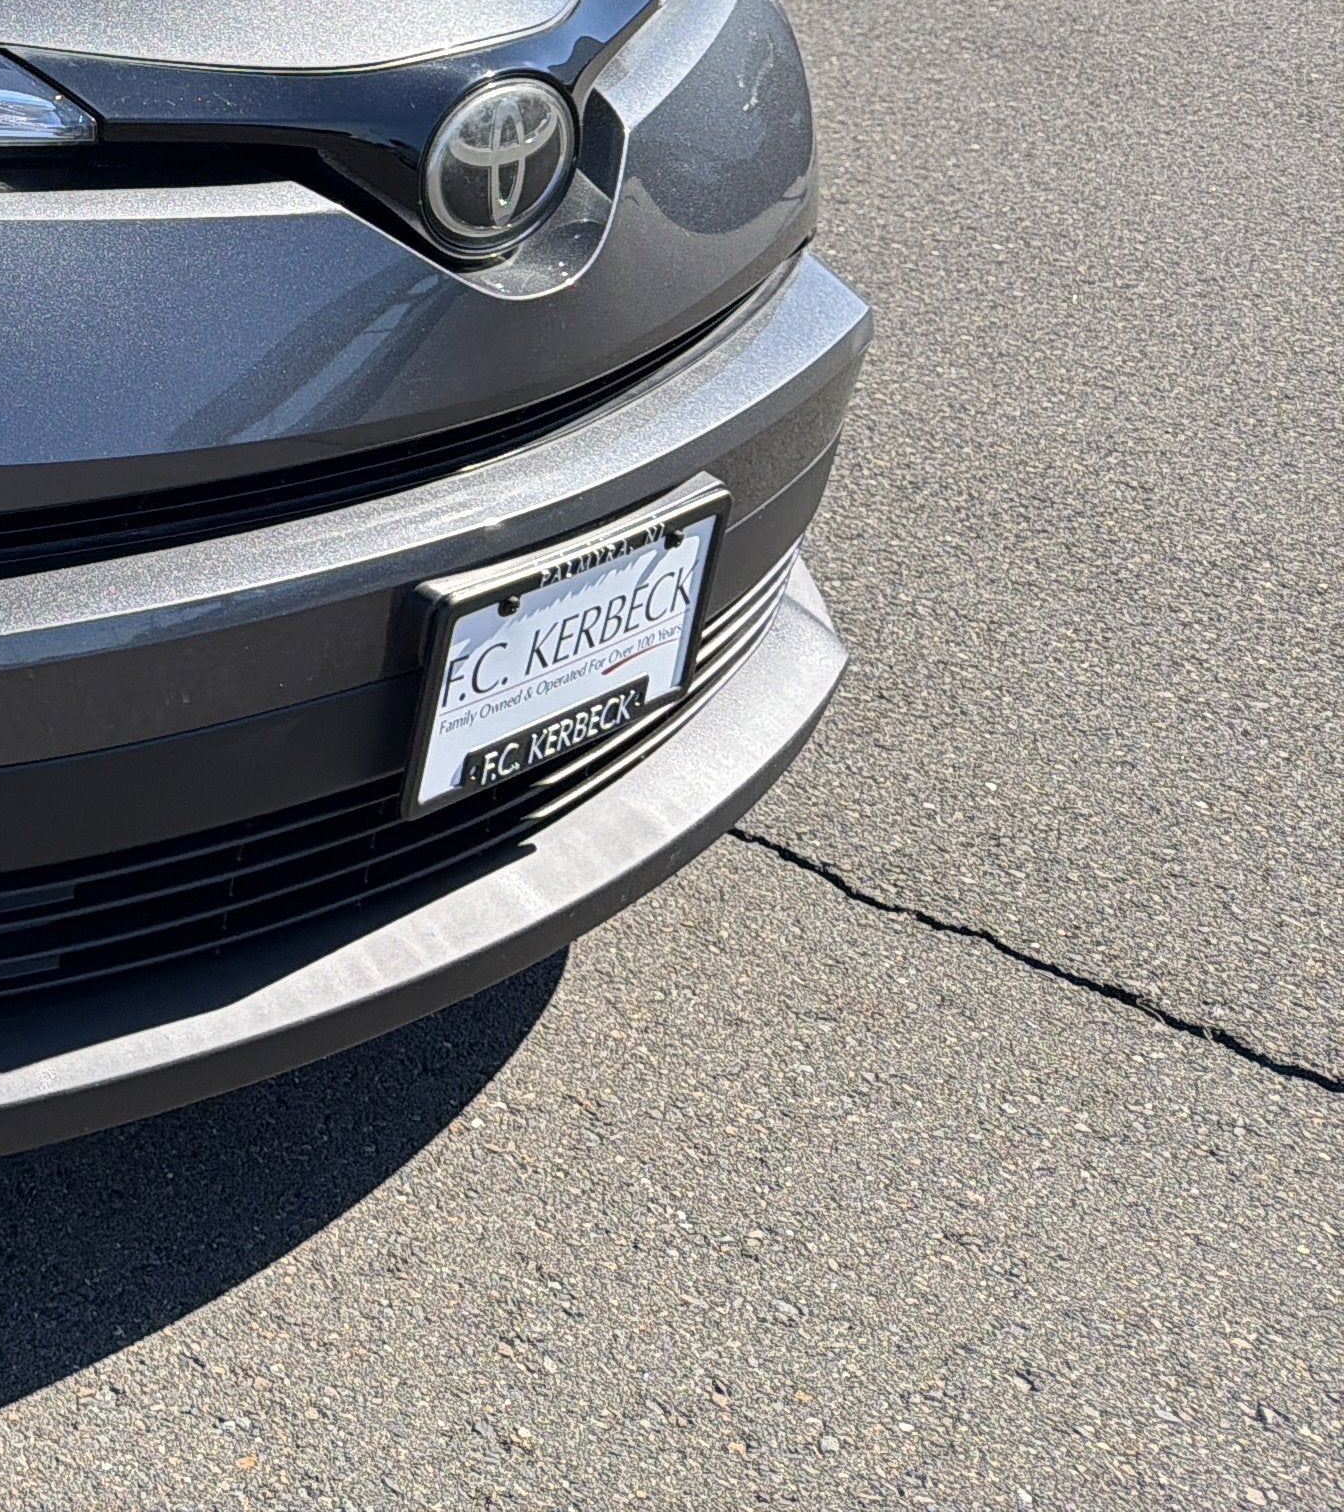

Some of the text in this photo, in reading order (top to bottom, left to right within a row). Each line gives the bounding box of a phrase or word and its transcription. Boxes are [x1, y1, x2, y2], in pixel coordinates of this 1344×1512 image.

[438, 624, 682, 736] Family Owned & Operated For Over 100 Years
[441, 561, 698, 709] F.C. KERBECK
[480, 689, 636, 786] F.C. KERBECK
